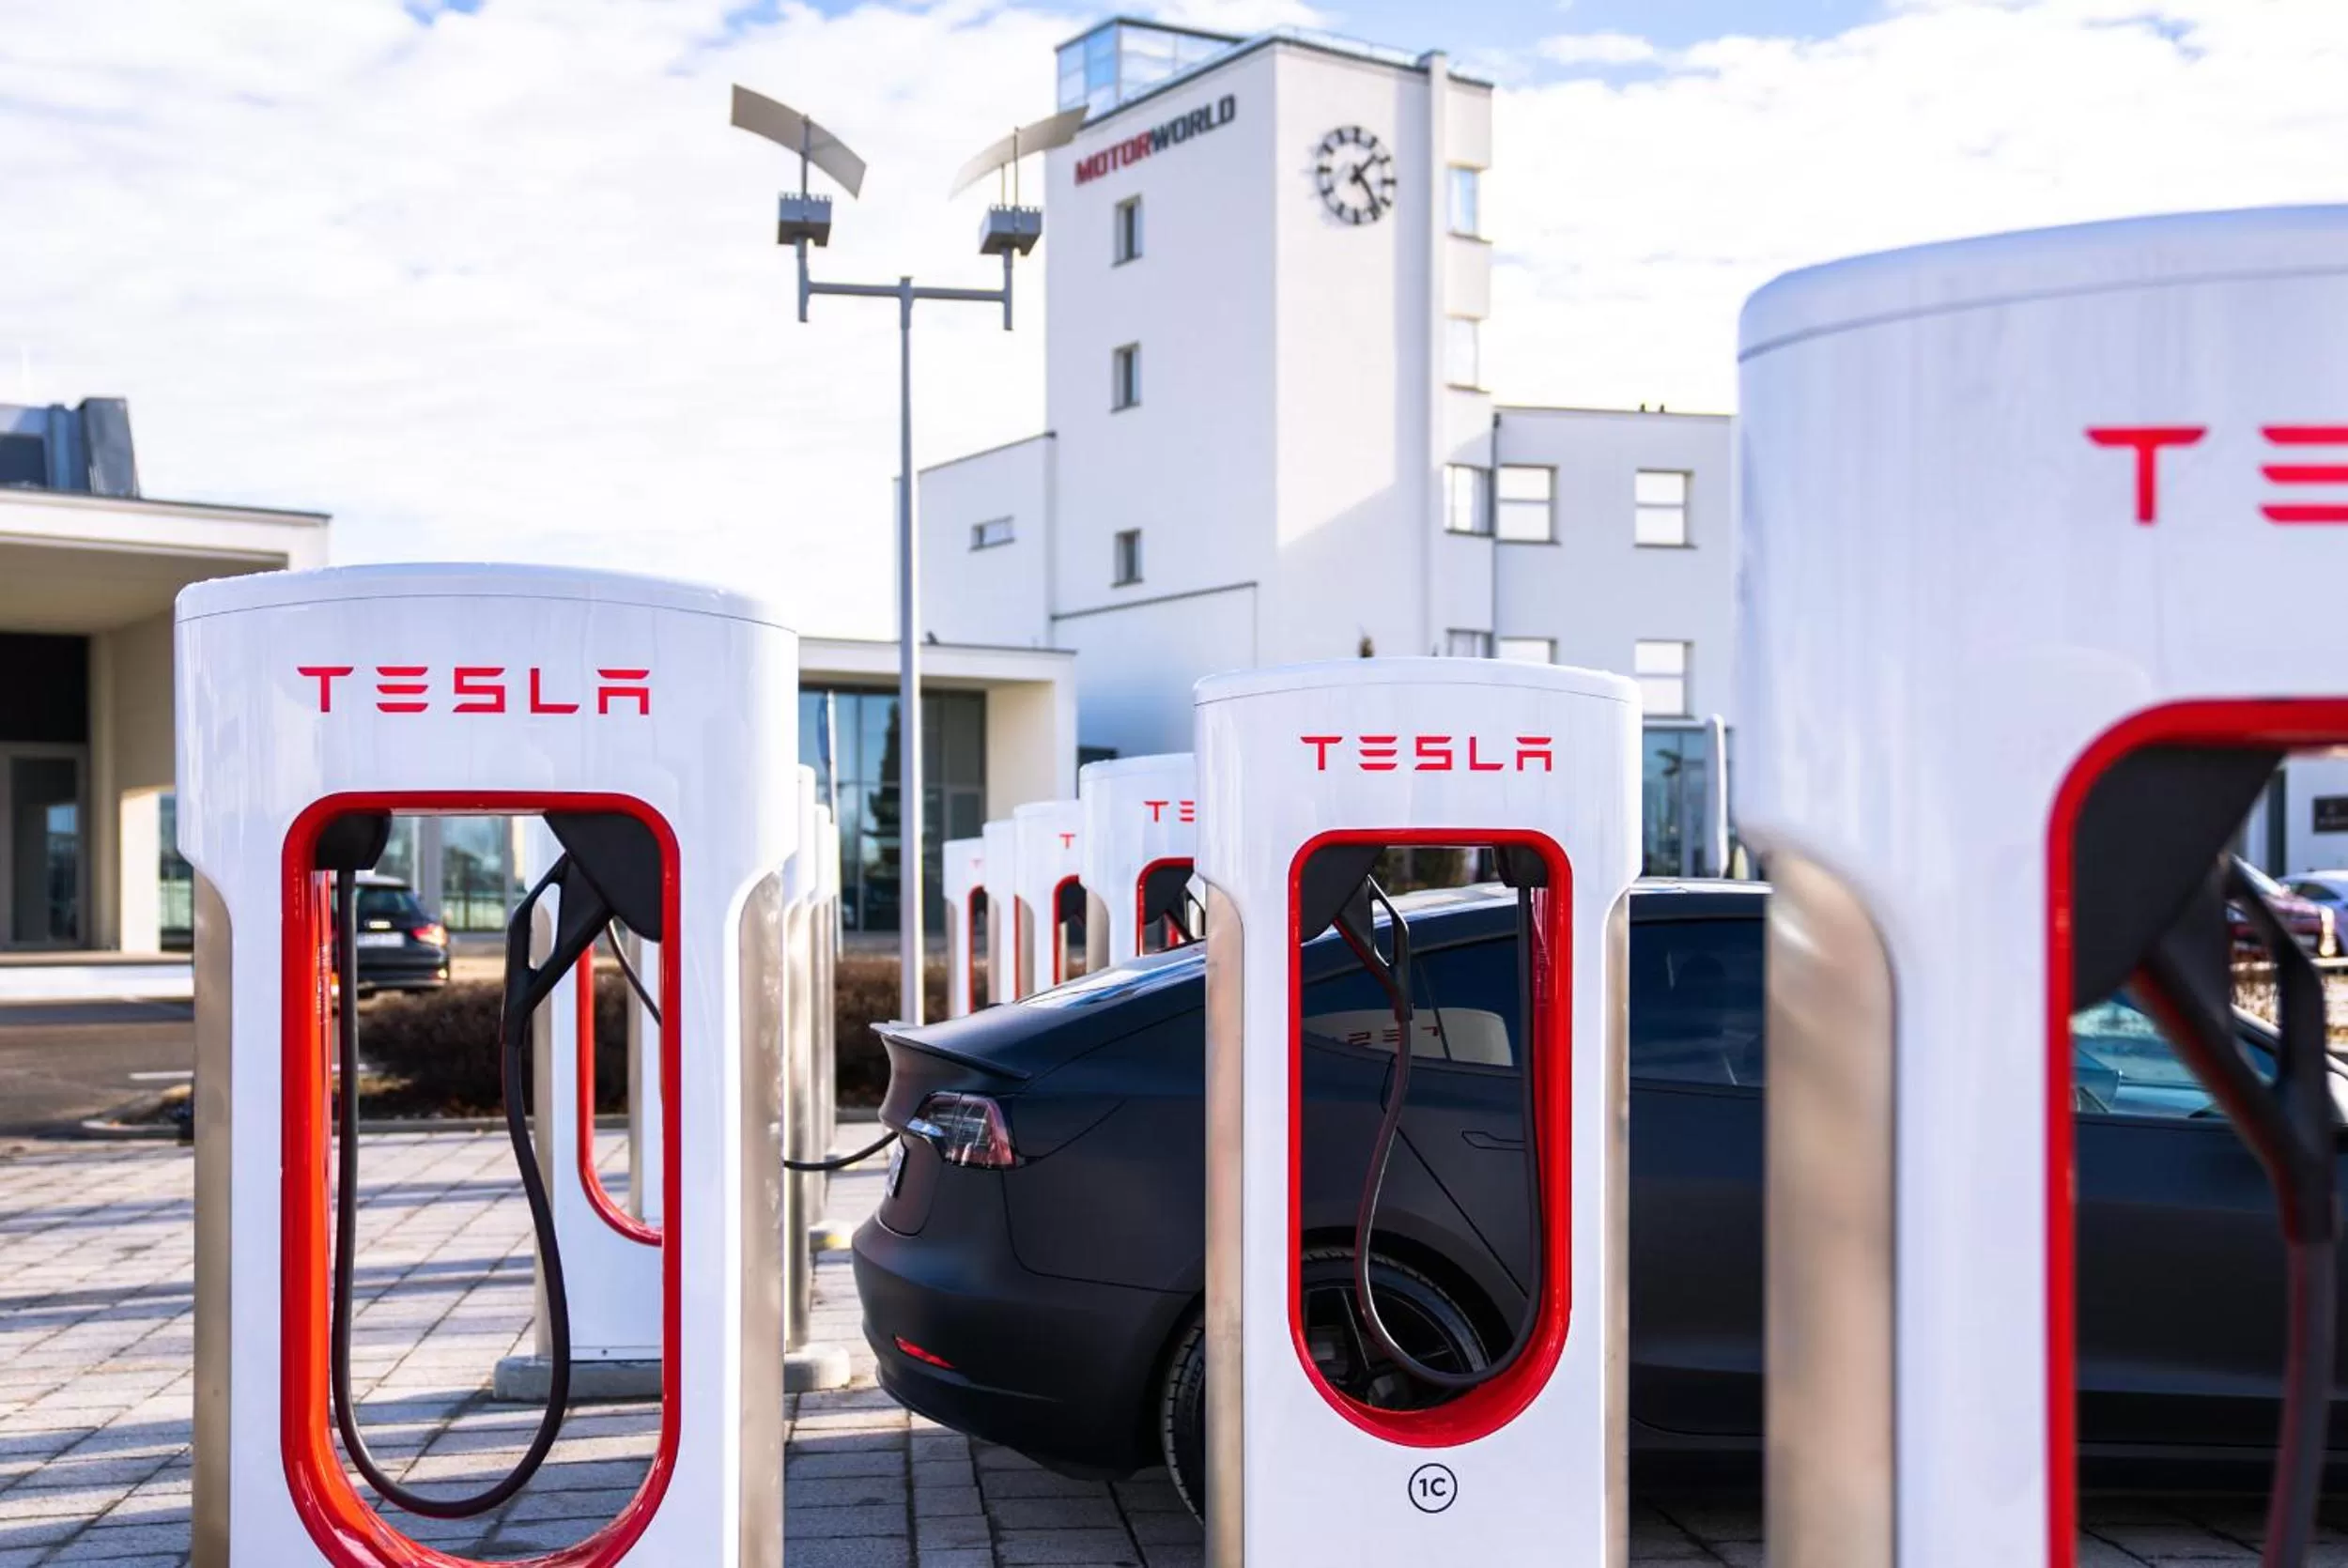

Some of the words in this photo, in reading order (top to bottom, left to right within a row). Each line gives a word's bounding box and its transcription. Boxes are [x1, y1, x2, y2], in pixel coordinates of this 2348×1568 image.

[1074, 93, 1237, 186] MOTORWORLD
[296, 666, 651, 715] TESLA
[1299, 735, 1553, 772] TESLA
[1418, 1477, 1447, 1497] 1C
